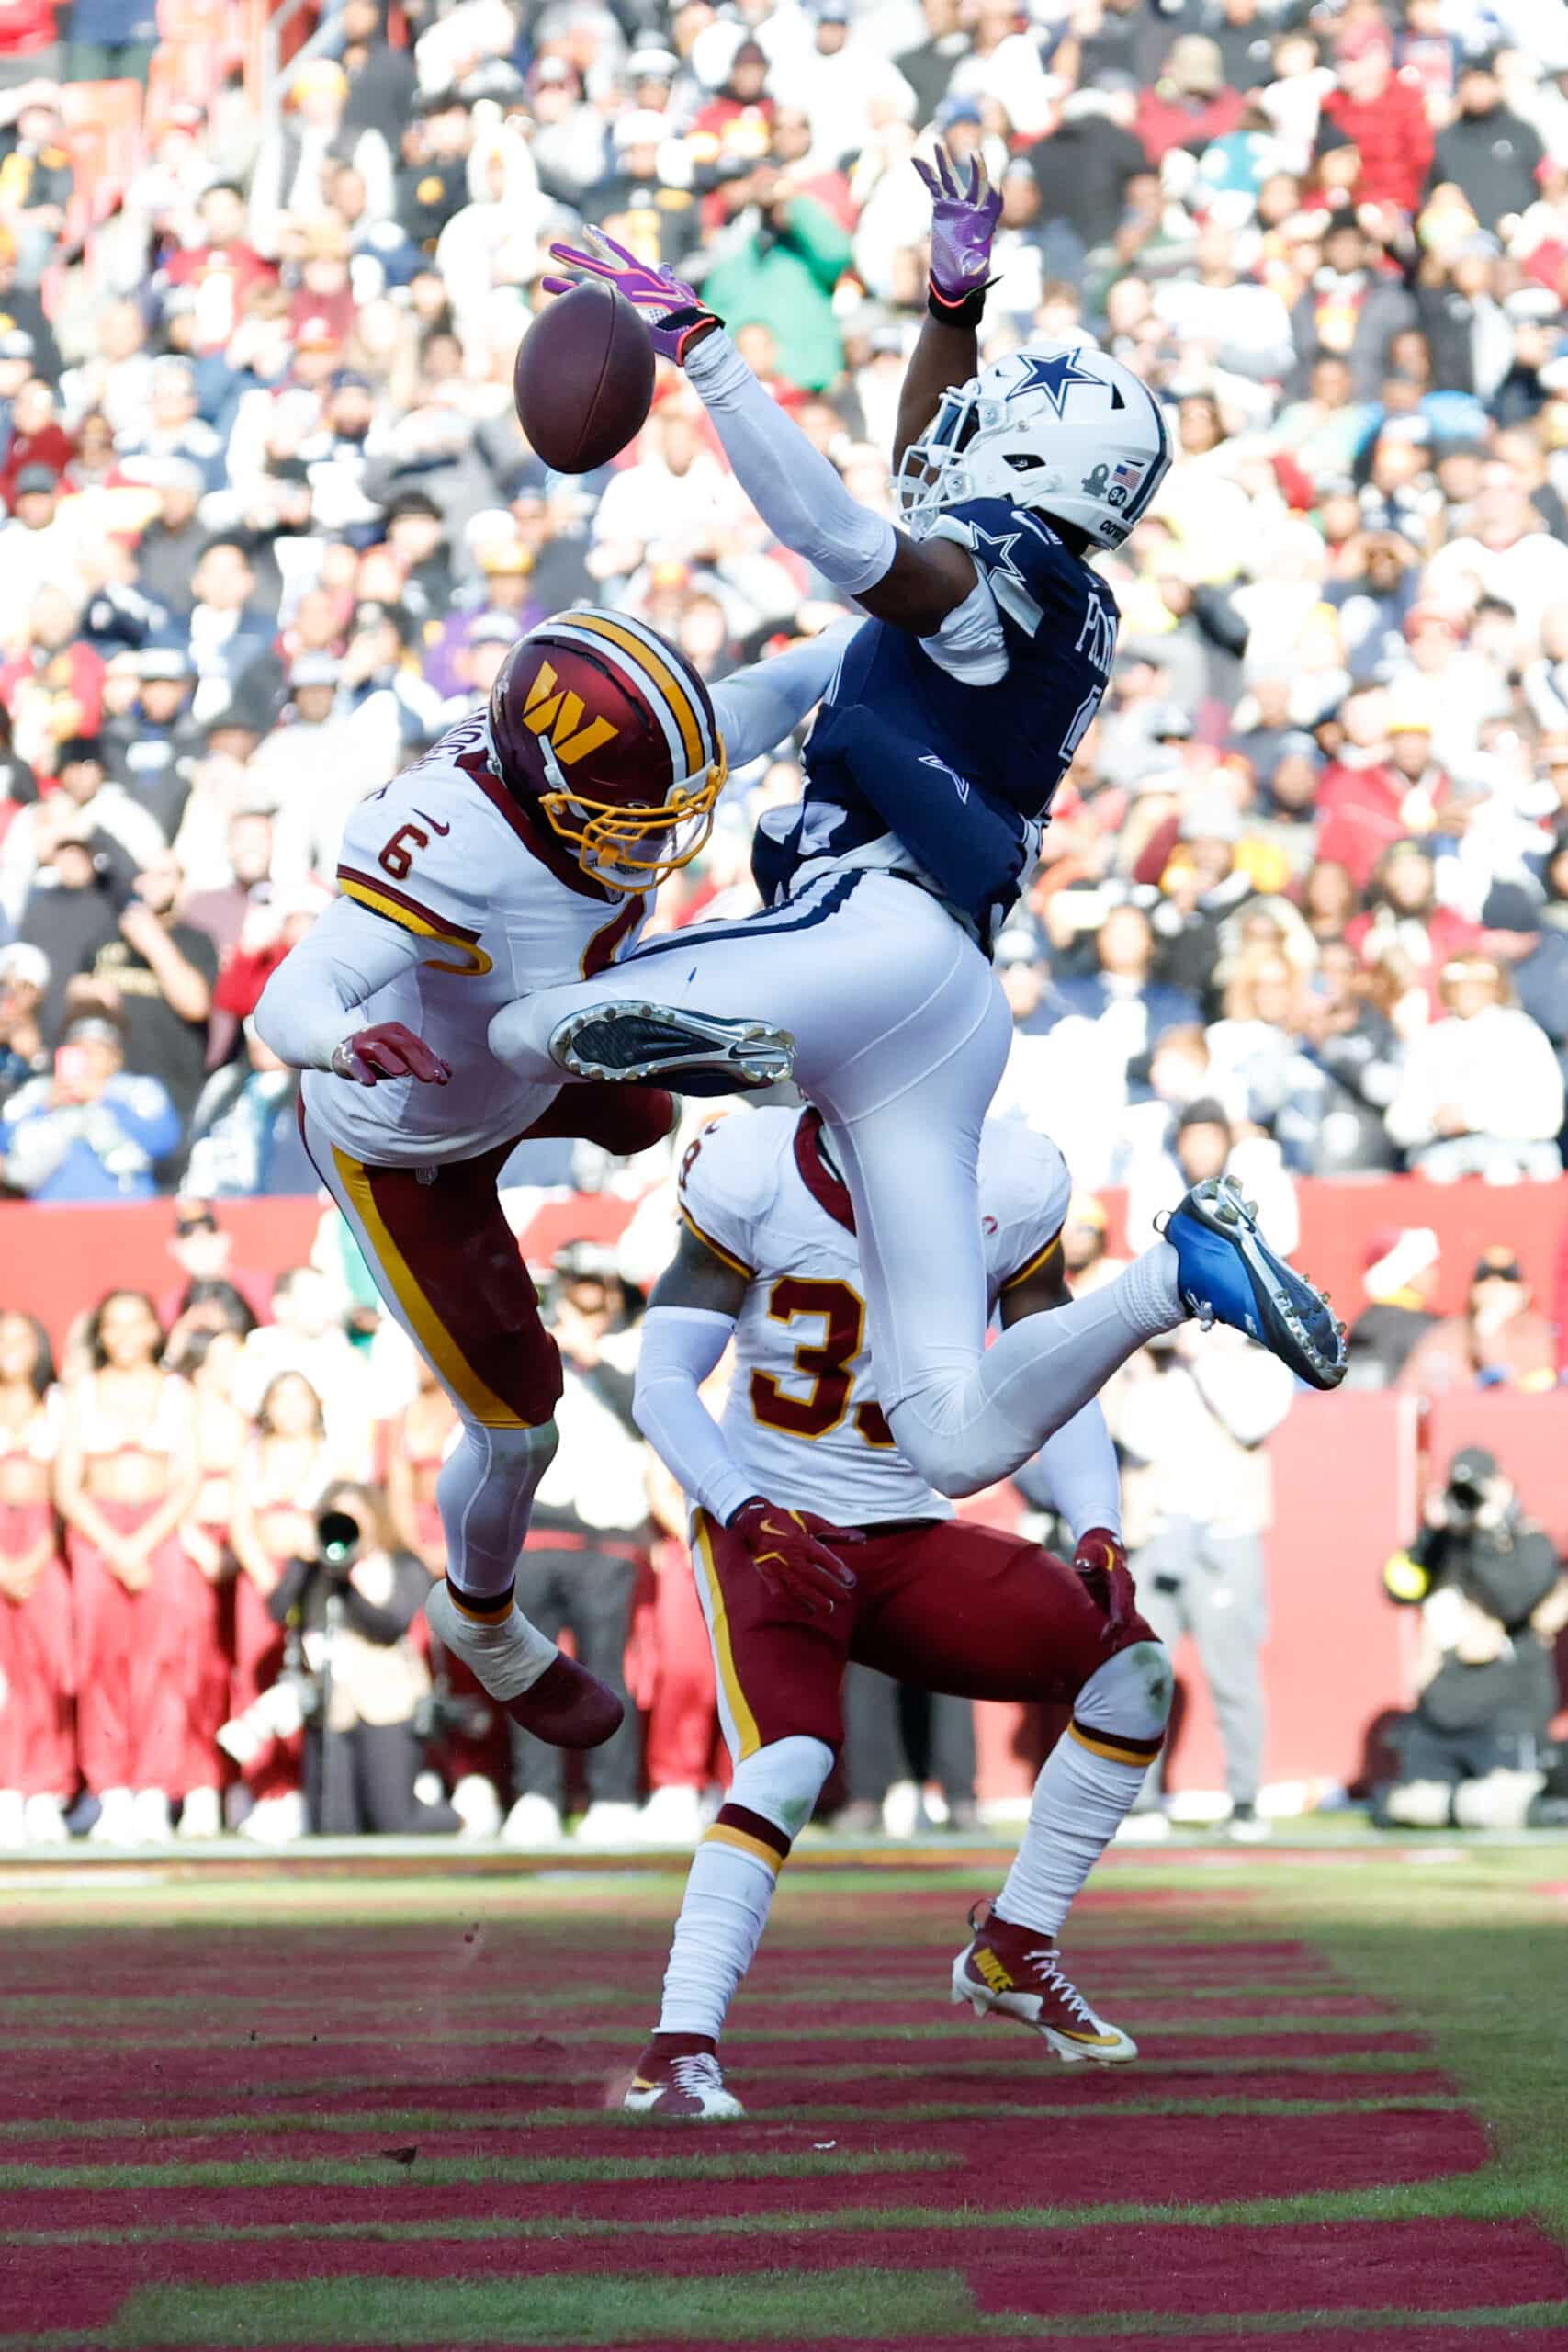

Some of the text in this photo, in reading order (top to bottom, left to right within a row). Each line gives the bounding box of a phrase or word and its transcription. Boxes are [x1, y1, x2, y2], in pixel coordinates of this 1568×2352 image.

[1109, 488, 1126, 504] 94
[522, 660, 620, 765] W
[378, 823, 431, 881] 6
[750, 1275, 898, 1449] 3
[972, 1947, 1014, 1994] NIKE
